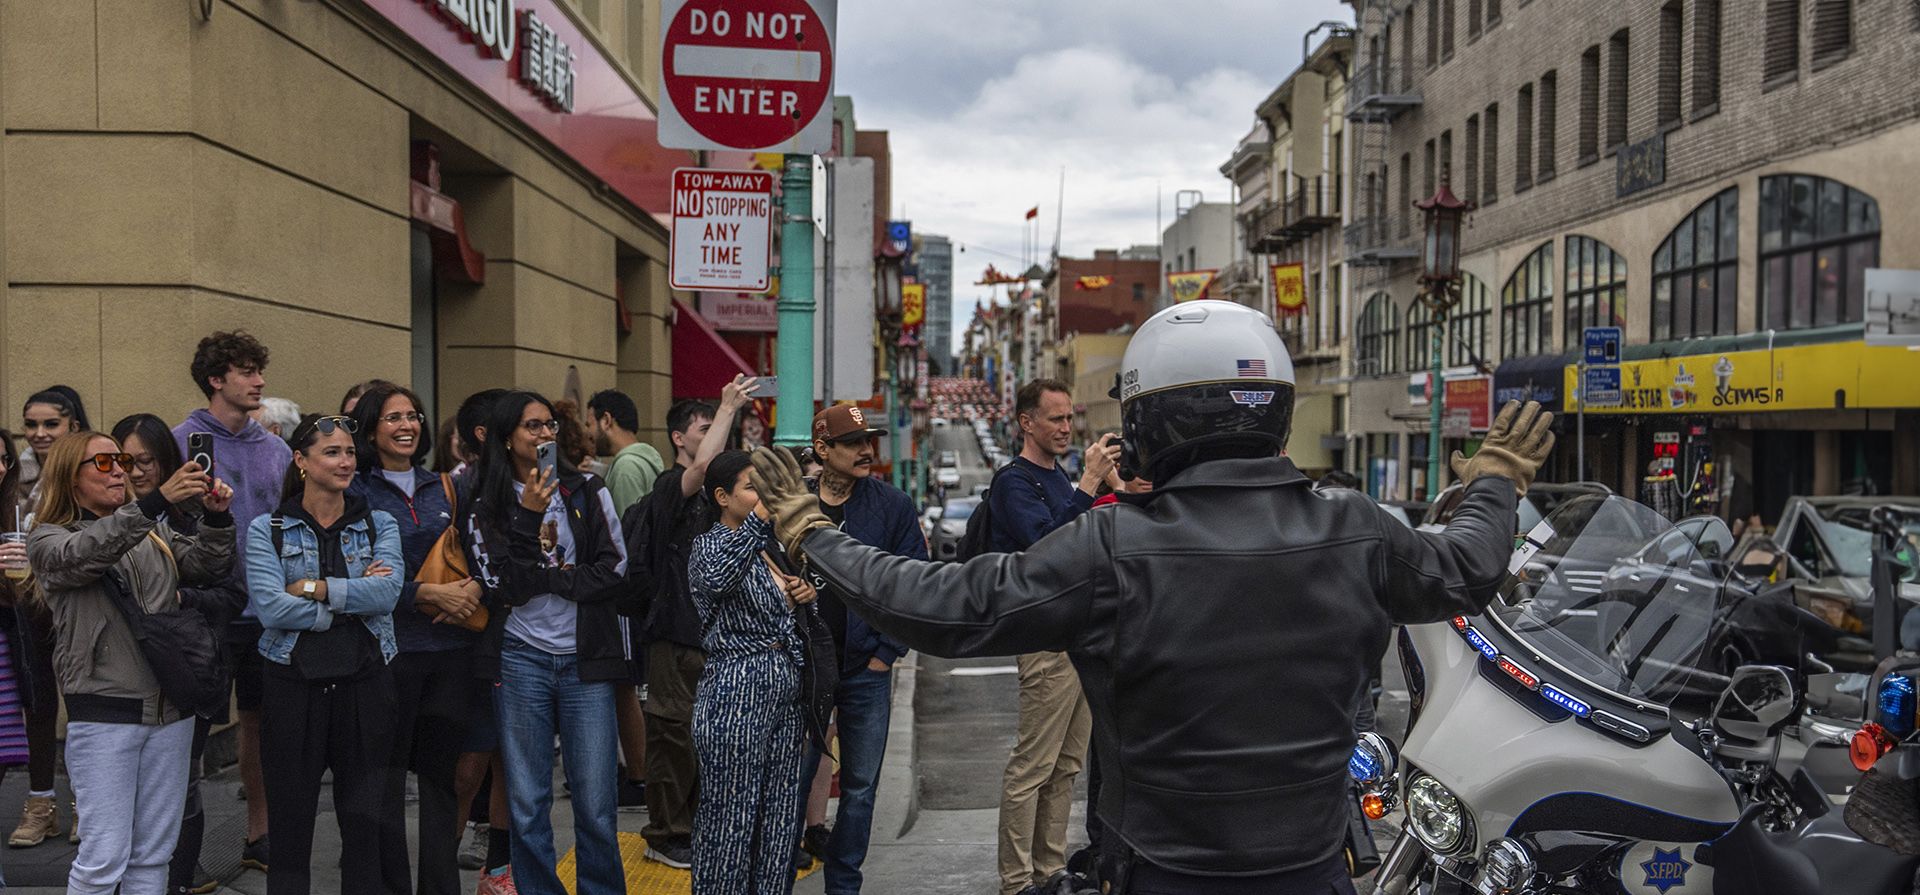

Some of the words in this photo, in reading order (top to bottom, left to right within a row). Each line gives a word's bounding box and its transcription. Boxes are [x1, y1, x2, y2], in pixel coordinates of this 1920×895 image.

[690, 9, 731, 37] DO
[746, 12, 806, 39] NOT
[695, 86, 799, 117] ENTER
[683, 173, 764, 190] TOW-AWAY
[676, 189, 701, 216] NO
[706, 196, 767, 218] STOPPING
[704, 222, 740, 241] ANY
[701, 245, 742, 265] TIME
[716, 303, 768, 316] IMPERIAL
[1586, 331, 1600, 341] Pay
[1601, 331, 1618, 339] here
[1639, 388, 1662, 409] STAR
